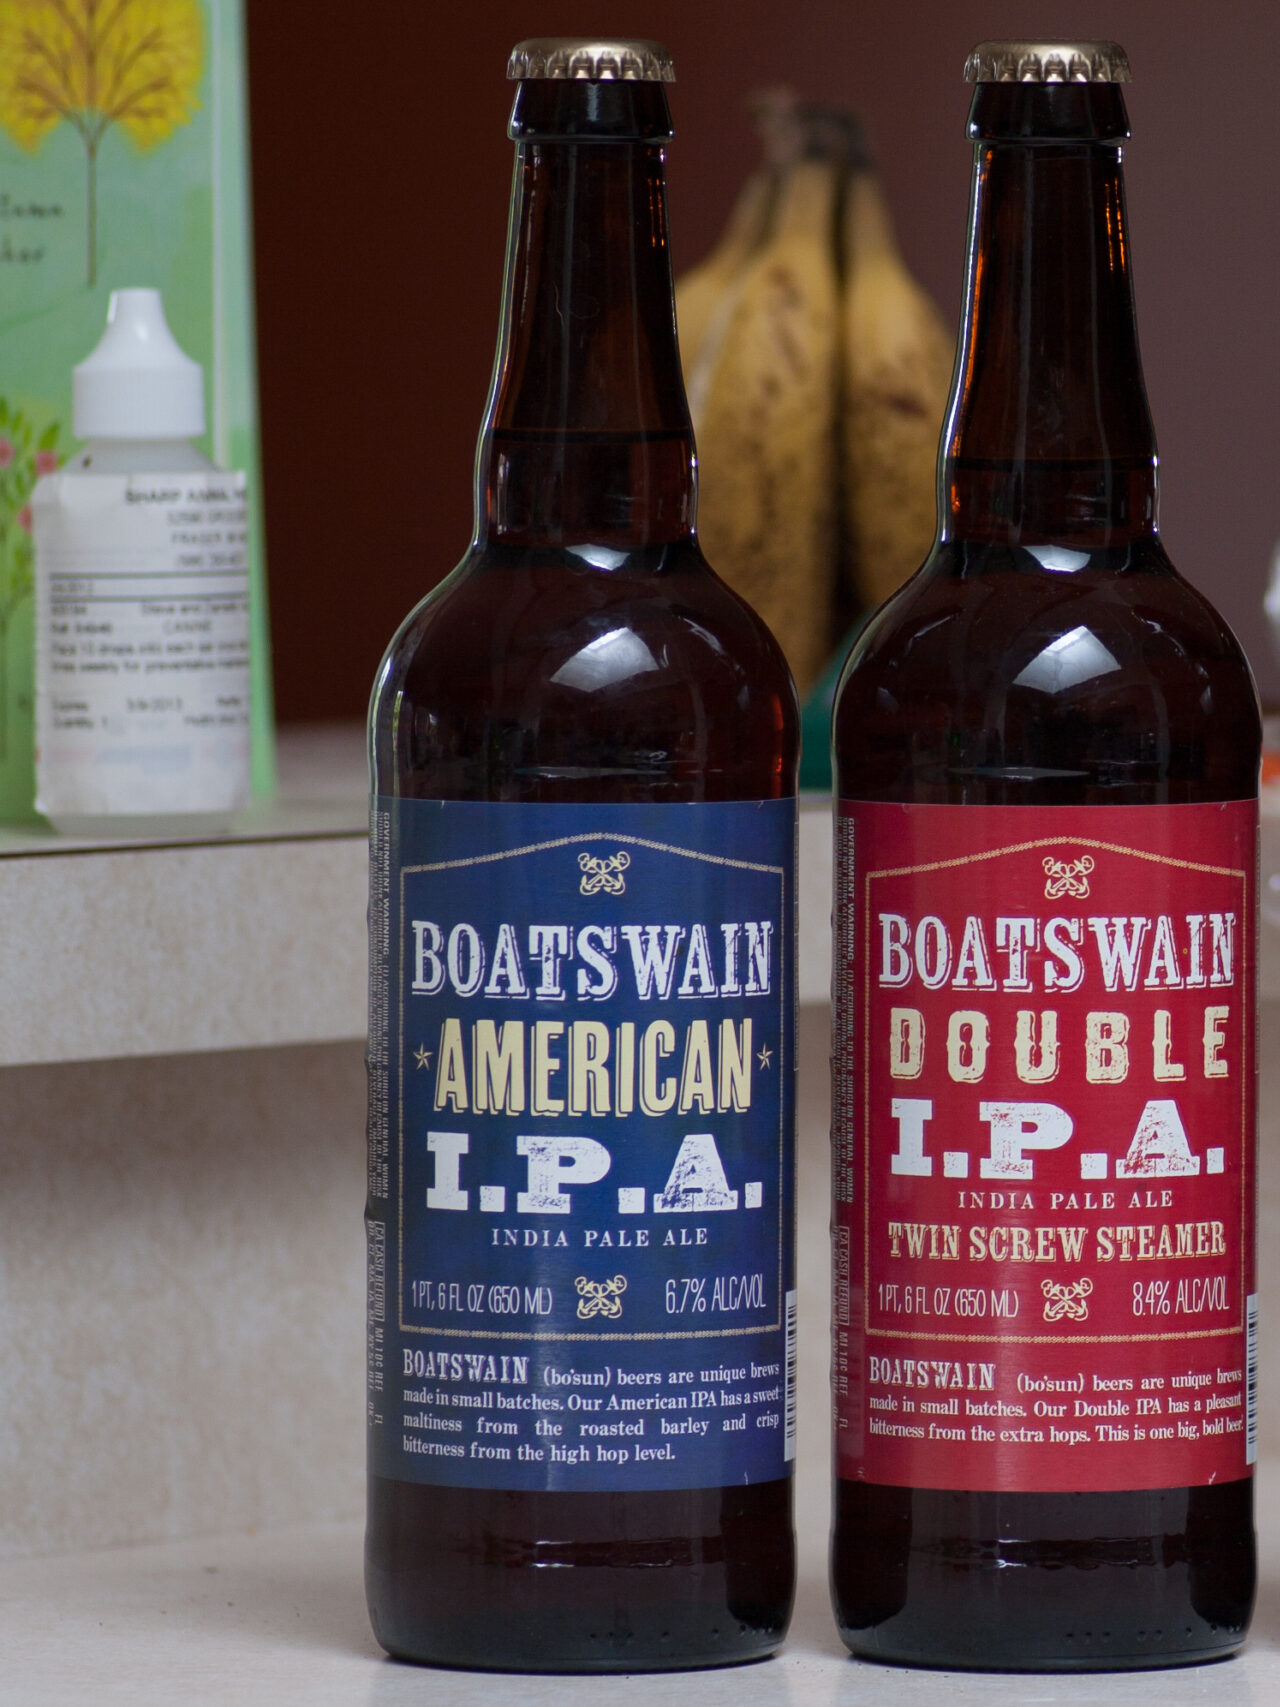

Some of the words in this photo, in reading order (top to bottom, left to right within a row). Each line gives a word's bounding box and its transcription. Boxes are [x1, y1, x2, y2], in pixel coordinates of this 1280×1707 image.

[412, 920, 773, 1001] BOATSWAIN
[879, 913, 1236, 993] BOATSWAIN
[890, 1006, 1229, 1084] DOUBLE
[434, 1018, 752, 1117] AMERICAN
[891, 1098, 1224, 1180] I.P.A.
[427, 1132, 762, 1214] I.P.A.
[959, 1192, 1034, 1209] INDIA
[1050, 1192, 1115, 1209] PALE
[1128, 1190, 1172, 1208] ALE
[492, 1229, 568, 1247] INDIA
[584, 1230, 649, 1247] PALE
[663, 1228, 707, 1246] ALE
[889, 1222, 962, 1260] TWIN
[969, 1226, 1088, 1262] SCREW
[1096, 1221, 1225, 1262] STEAMER
[666, 1278, 706, 1314] 6.7%
[1133, 1280, 1170, 1316] 8.4%
[403, 1349, 529, 1384] BOATSWAIN
[617, 1368, 662, 1385] beers
[668, 1372, 694, 1384] are
[700, 1365, 746, 1384] unique
[750, 1362, 779, 1378] brews
[870, 1357, 996, 1391] BOATSWAIN
[1093, 1375, 1133, 1391] beers
[1141, 1378, 1164, 1390] are
[1171, 1370, 1212, 1390] unique
[1217, 1368, 1242, 1384] brews
[870, 1394, 898, 1411] made
[902, 1396, 915, 1412] in
[920, 1398, 959, 1415] small
[966, 1399, 1027, 1417] batches.
[1034, 1400, 1067, 1417] Our
[1074, 1399, 1130, 1417] Double
[1136, 1398, 1162, 1415] IPA
[1168, 1397, 1190, 1413] has
[1194, 1400, 1202, 1411] a
[1206, 1392, 1241, 1414] pleasant
[404, 1412, 462, 1432] maltiness
[477, 1416, 518, 1435] from
[535, 1418, 562, 1436] the
[580, 1419, 644, 1436] roasted
[661, 1417, 709, 1436] barley
[722, 1413, 746, 1431] and
[756, 1411, 779, 1428] crisp
[869, 1417, 925, 1439] bitterness
[928, 1423, 966, 1440] from
[971, 1425, 996, 1441] the
[999, 1427, 1044, 1442] extra
[1049, 1426, 1091, 1445] hops.
[1095, 1425, 1129, 1441] This
[1134, 1424, 1146, 1440] is
[1149, 1427, 1174, 1439] one
[1177, 1421, 1200, 1440] big,
[1202, 1417, 1224, 1436] bold
[403, 1435, 465, 1457] bitterness
[470, 1442, 511, 1460] from
[517, 1444, 544, 1461] the
[550, 1444, 590, 1464] high
[597, 1445, 629, 1464] hop
[635, 1443, 675, 1461] level.
